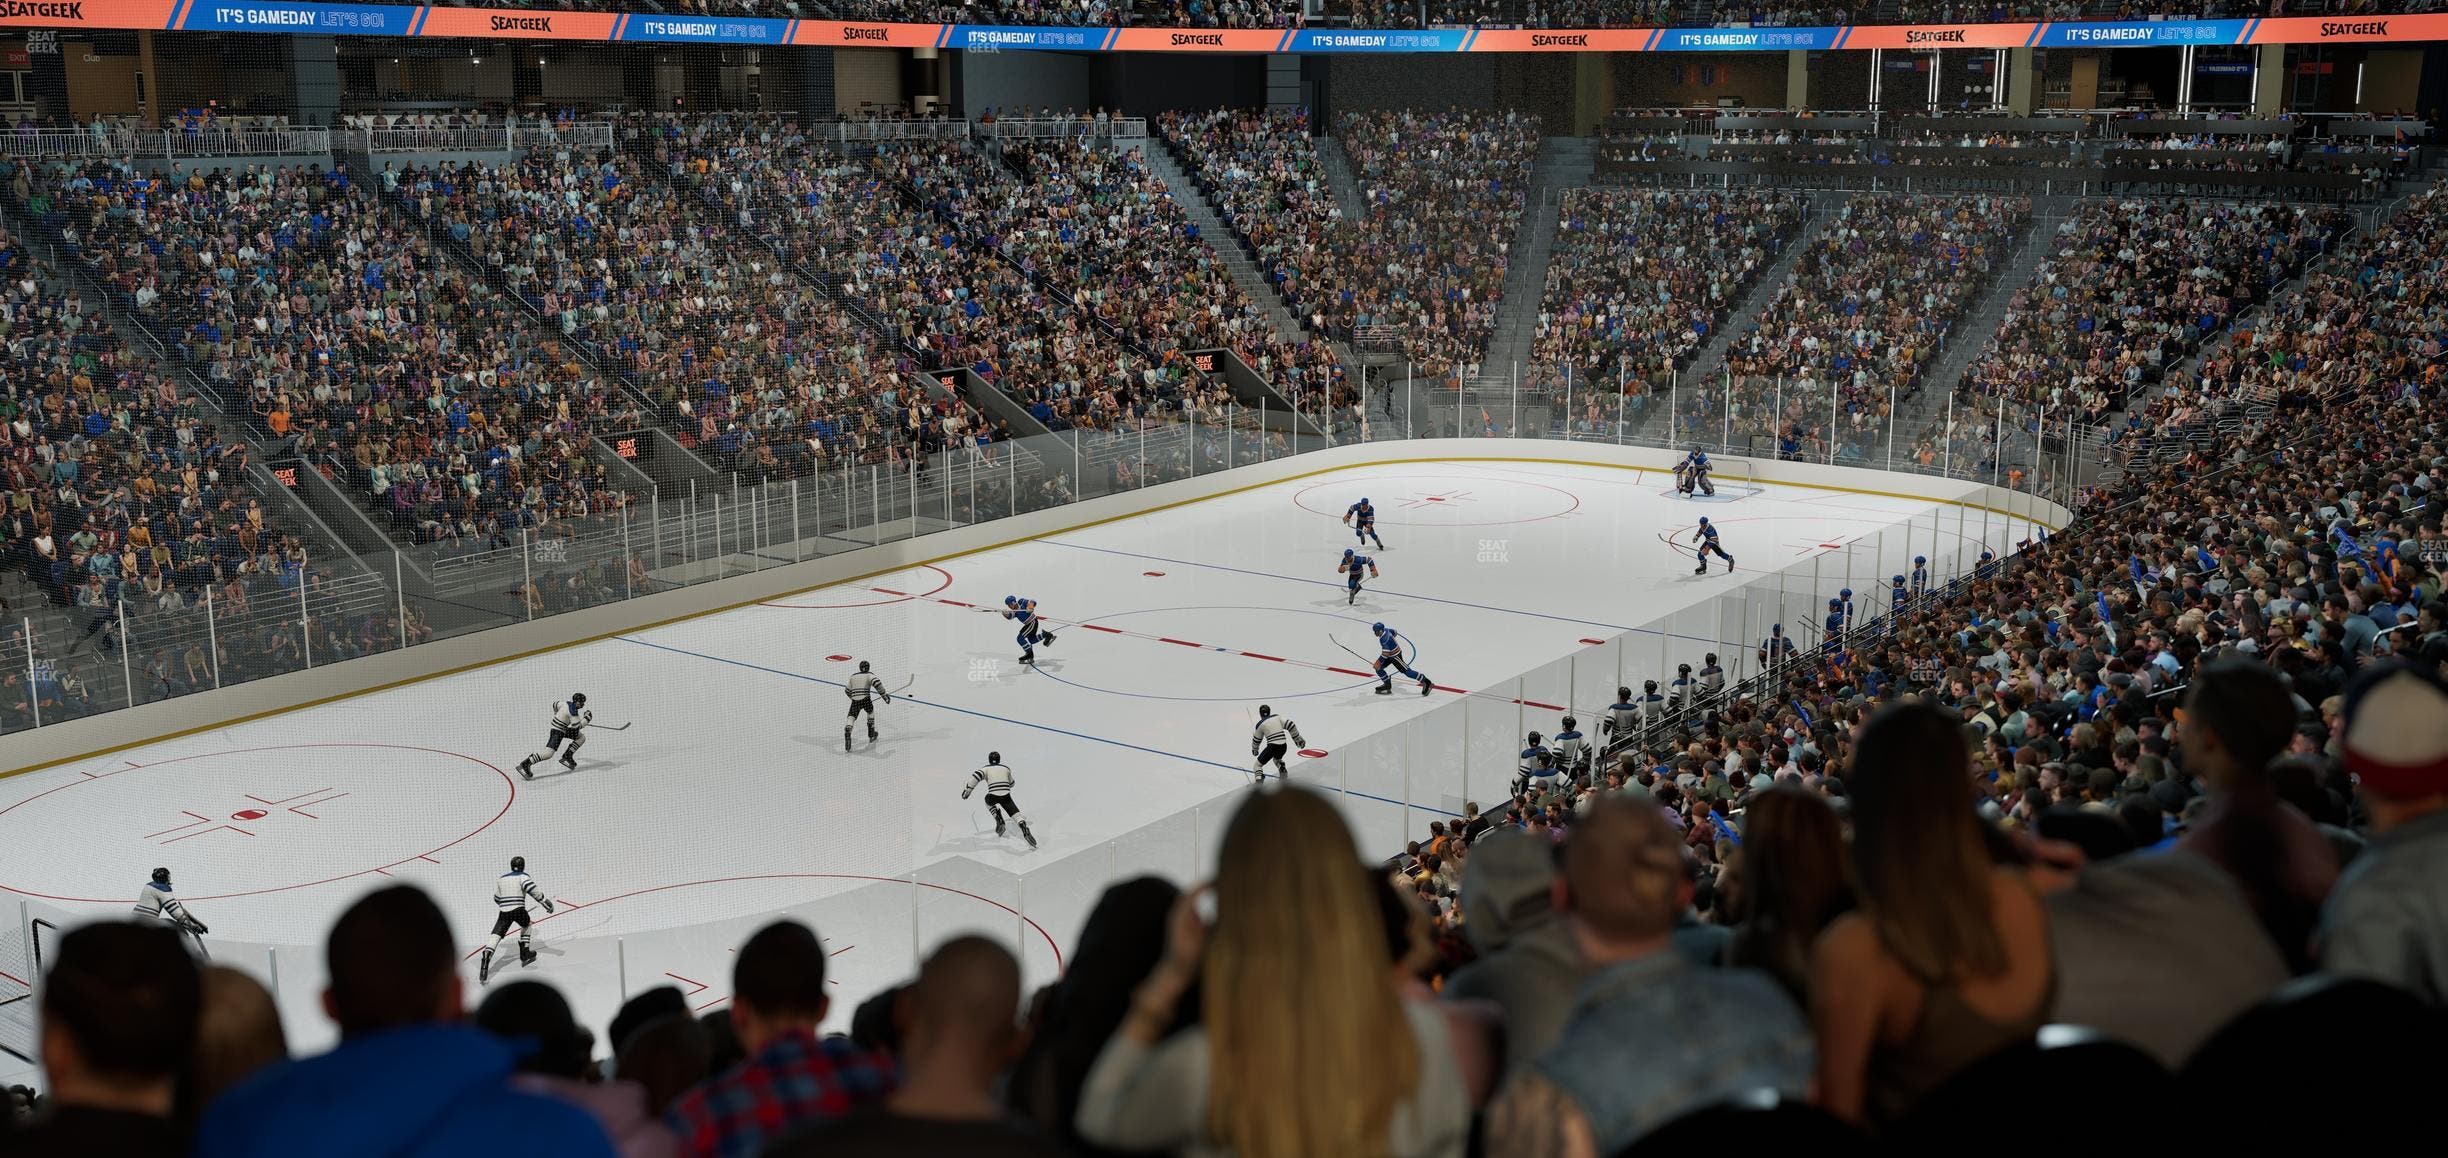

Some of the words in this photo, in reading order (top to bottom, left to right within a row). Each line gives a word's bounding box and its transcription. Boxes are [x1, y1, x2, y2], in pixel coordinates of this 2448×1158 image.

[0, 1, 84, 20] SEATGEEK
[216, 9, 244, 23] IT'S
[247, 10, 316, 25] GAMEDAY
[320, 11, 358, 26] LET'S
[360, 13, 385, 28] GO!
[491, 15, 552, 33] SEATGEEK
[645, 22, 666, 35] IT'S
[668, 23, 717, 36] GAMEDAY
[719, 23, 747, 37] LET'S
[749, 25, 766, 38] GO!
[843, 26, 889, 42] SEATGEEK
[2066, 29, 2090, 41] IT'S
[2092, 27, 2154, 41] GAMEDAY
[2156, 28, 2193, 41] LET'S
[2195, 26, 2217, 39] GO!
[2320, 20, 2388, 37] SEATGEEK
[968, 31, 988, 43] IT'S
[989, 32, 1036, 44] GAMEDAY
[1037, 32, 1064, 45] LET'S
[1066, 34, 1084, 46] GO!
[1171, 32, 1223, 46] SEATGEEK
[1313, 36, 1333, 46] IT'S
[1335, 36, 1386, 47] GAMEDAY
[1389, 36, 1418, 47] LET'S
[1420, 36, 1440, 47] GO!
[1531, 34, 1588, 47] SEATGEEK
[1680, 34, 1701, 46] IT'S
[1703, 34, 1758, 46] GAMEDAY
[1760, 34, 1791, 46] LET'S
[1793, 33, 1814, 46] GO!
[1906, 29, 1966, 43] SEATGEEK
[9, 54, 26, 62] EXIT
[83, 54, 101, 63] Club
[1195, 355, 1213, 364] SEAT
[941, 376, 955, 386] SEAT
[617, 439, 636, 450] SEAT
[274, 468, 295, 479] SEAT
